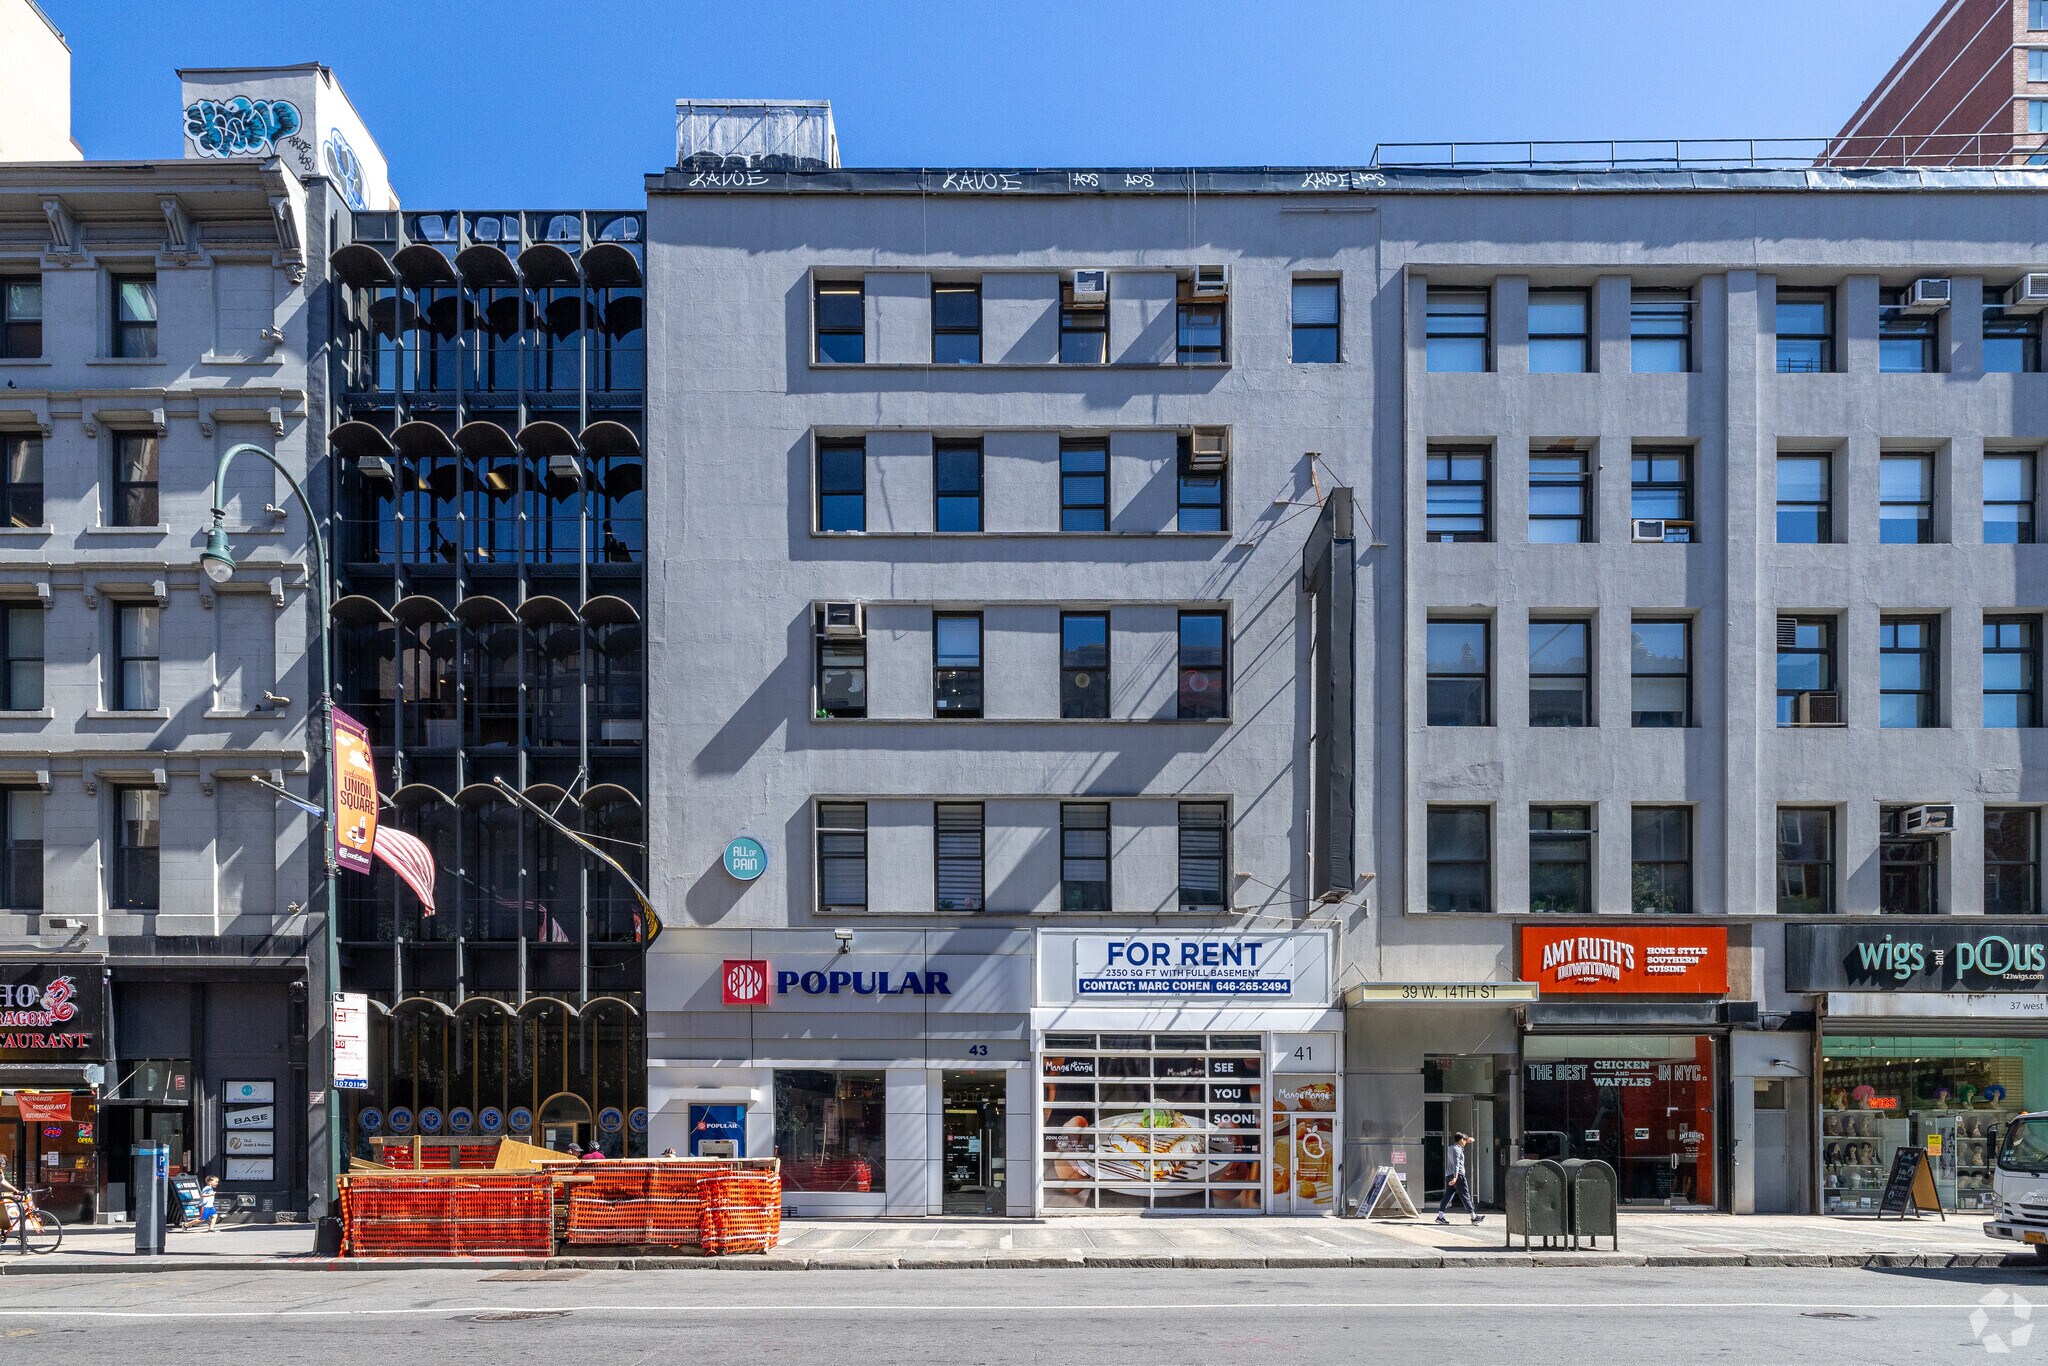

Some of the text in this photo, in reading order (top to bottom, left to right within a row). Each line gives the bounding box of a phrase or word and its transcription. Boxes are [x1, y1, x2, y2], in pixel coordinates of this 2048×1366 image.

[344, 776, 372, 800] UNION
[340, 790, 375, 815] SQUARE
[733, 846, 748, 857] ALL
[733, 858, 758, 870] PAIN
[1108, 942, 1263, 966] FOR RENT
[1543, 937, 1635, 970] AMY RUTH'S
[1647, 947, 1707, 955] HOME STYLE
[1647, 956, 1699, 964] SOUTHERN
[1858, 934, 1925, 980] wigs
[1933, 949, 1944, 966] and
[1106, 969, 1260, 978] 2350 SQ FT WITH FULL BASEMENT
[1557, 962, 1620, 980] DOWNTOWN
[2002, 973, 2045, 981] 123wigs.com
[777, 971, 953, 995] POPULAR
[1083, 981, 1288, 991] CONTACT: MARC COHEN 646-265-2494
[1402, 985, 1498, 998] 39 W. 14TH ST
[2010, 1002, 2044, 1010] 37 west
[969, 1045, 988, 1056] 43
[1294, 1046, 1312, 1060] 41
[1214, 1062, 1234, 1073] SEE
[1593, 1060, 1650, 1070] CHICKEN
[1529, 1064, 1588, 1081] THE BEST
[1658, 1064, 1708, 1081] IN NYC.
[1593, 1077, 1651, 1087] WAFFLES
[1214, 1088, 1241, 1099] YOU
[1869, 1097, 1897, 1109] WIGS
[233, 1113, 268, 1125] BASE
[1214, 1114, 1256, 1124] SOON!
[160, 1156, 165, 1165] P
